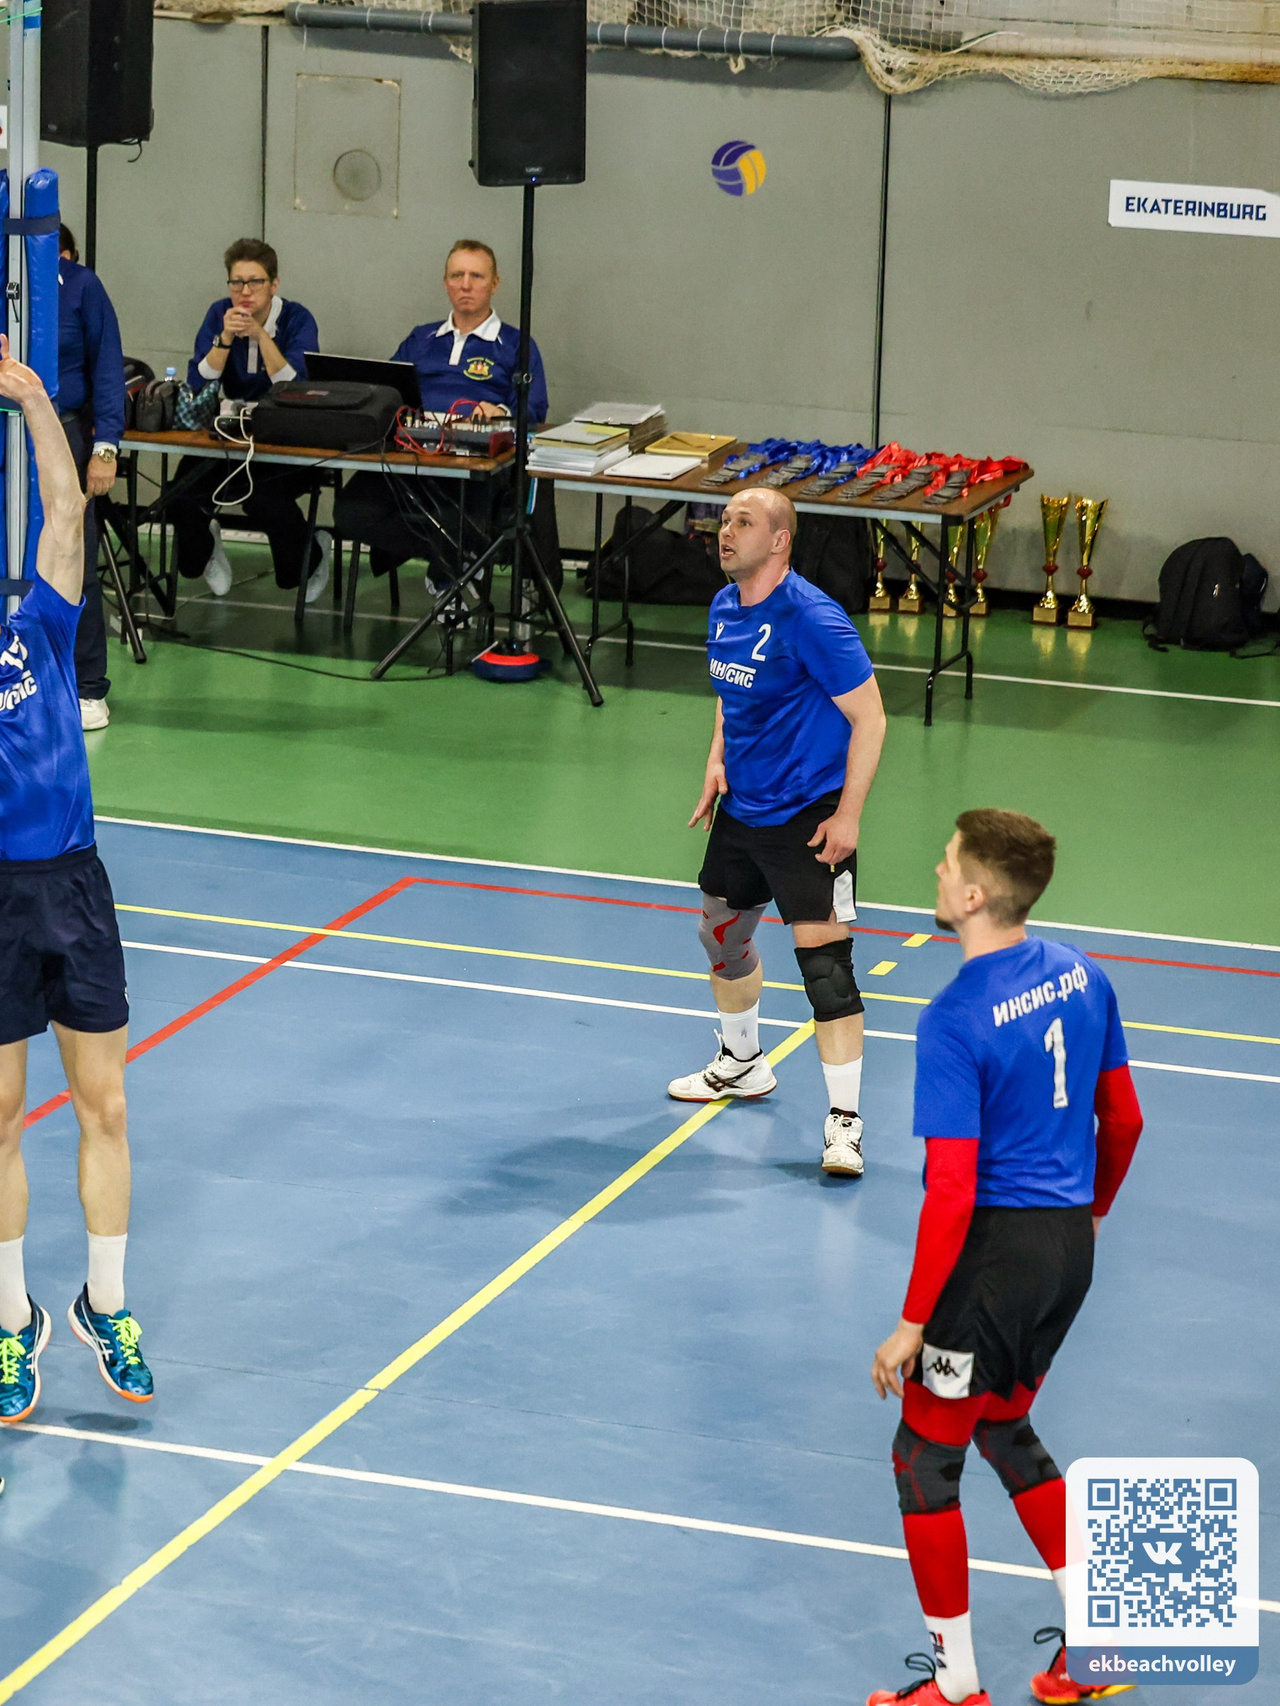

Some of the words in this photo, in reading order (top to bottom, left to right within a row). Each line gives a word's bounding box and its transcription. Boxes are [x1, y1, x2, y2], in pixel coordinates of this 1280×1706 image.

[1125, 196, 1266, 221] EKATERINBURG
[751, 623, 771, 662] 2
[1043, 1017, 1069, 1110] 1
